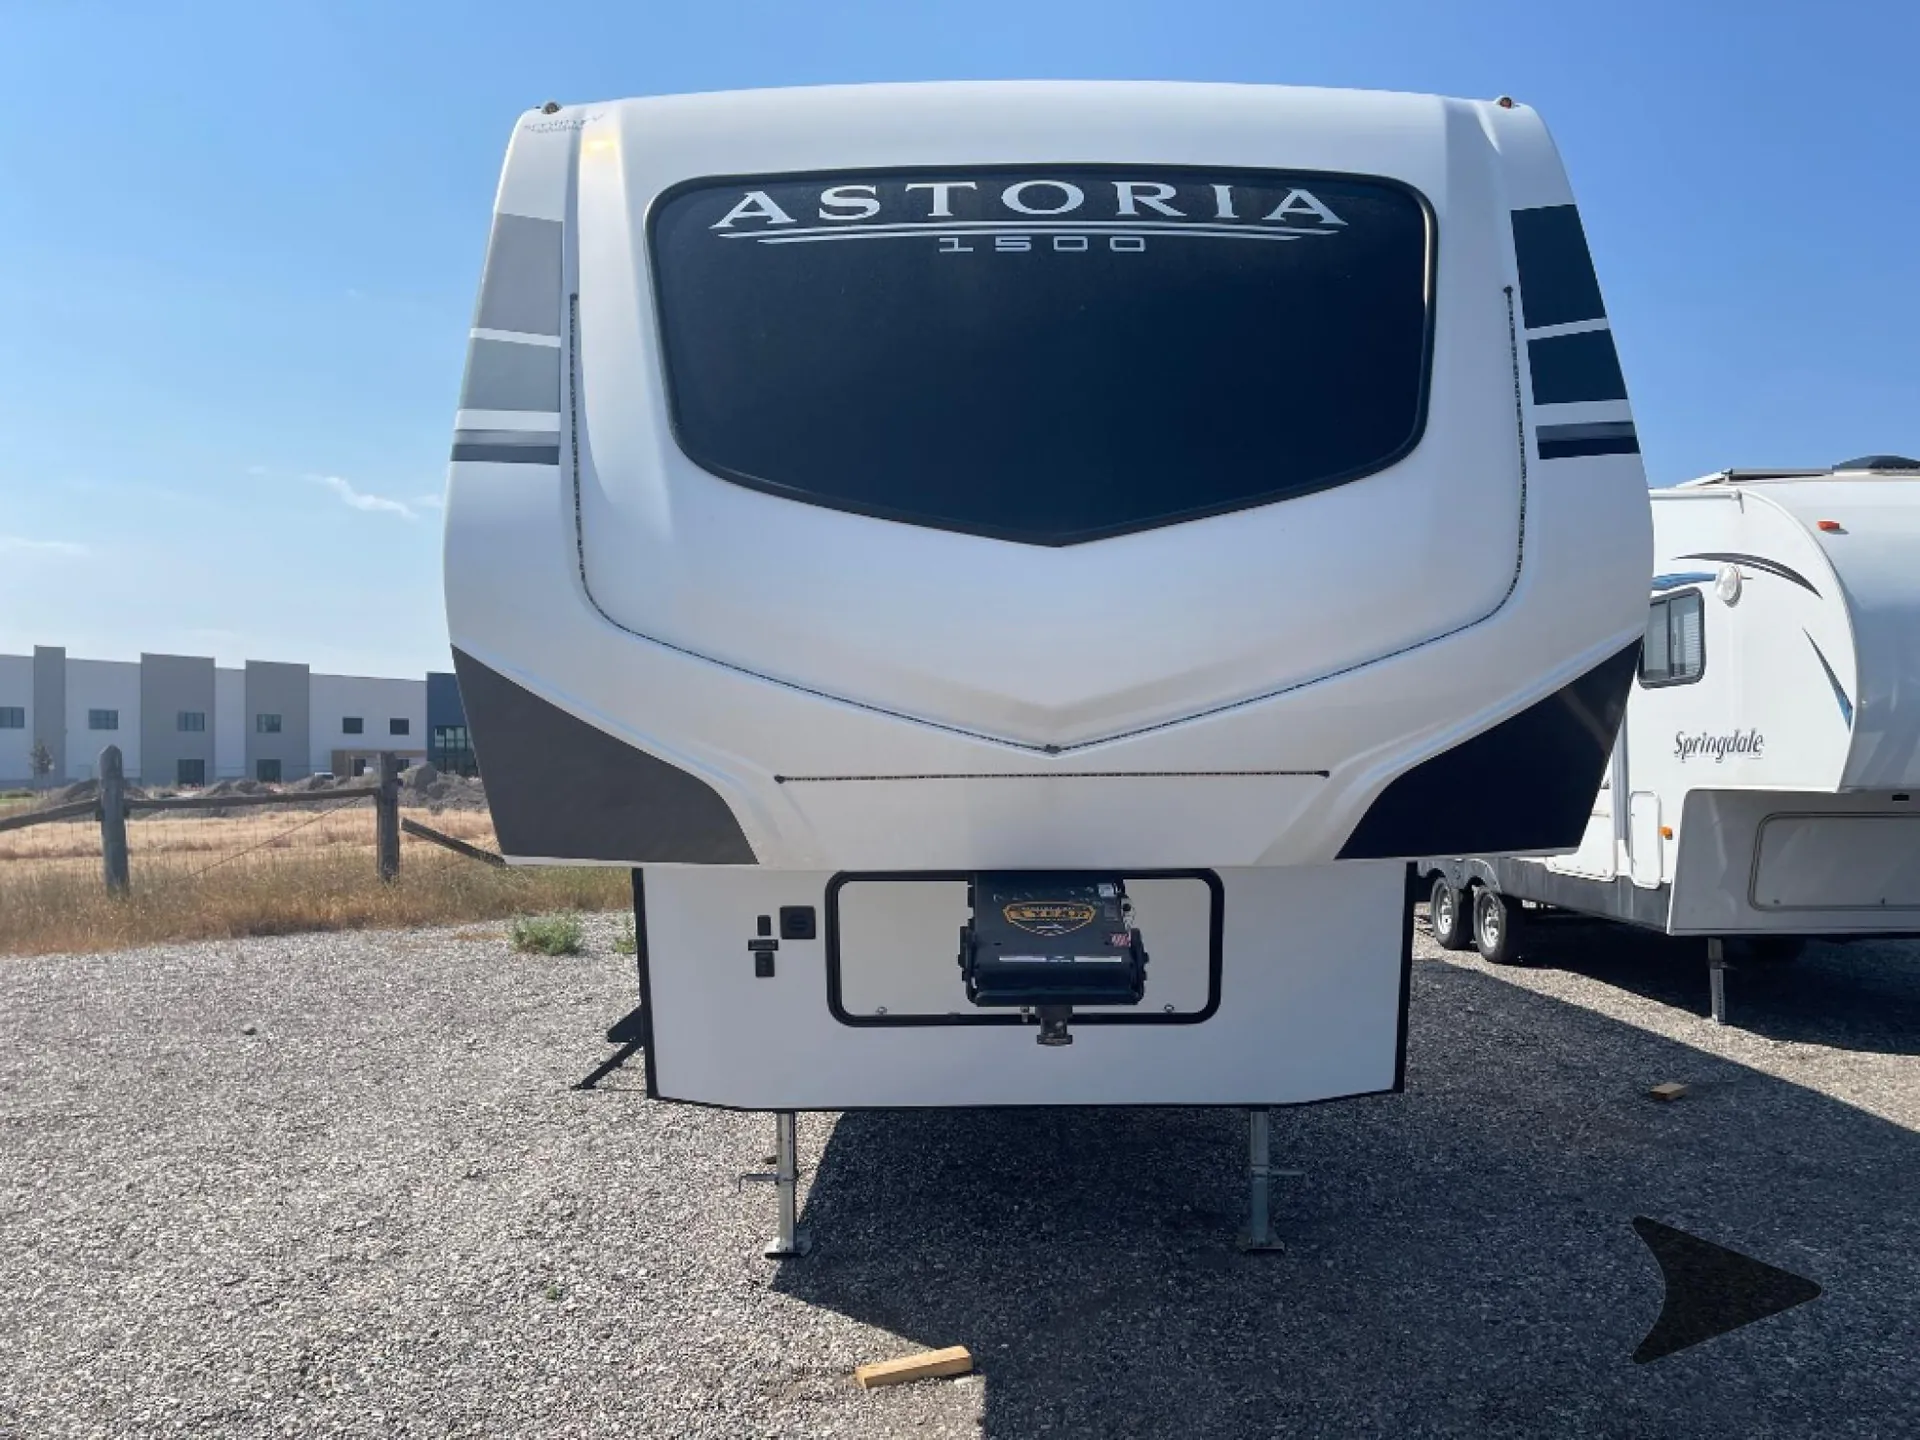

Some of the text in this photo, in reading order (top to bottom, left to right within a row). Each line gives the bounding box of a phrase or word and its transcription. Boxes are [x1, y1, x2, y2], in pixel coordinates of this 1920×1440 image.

[709, 180, 1349, 229] ASTORIA
[939, 236, 1145, 252] 1500
[1674, 728, 1764, 762] Springdale
